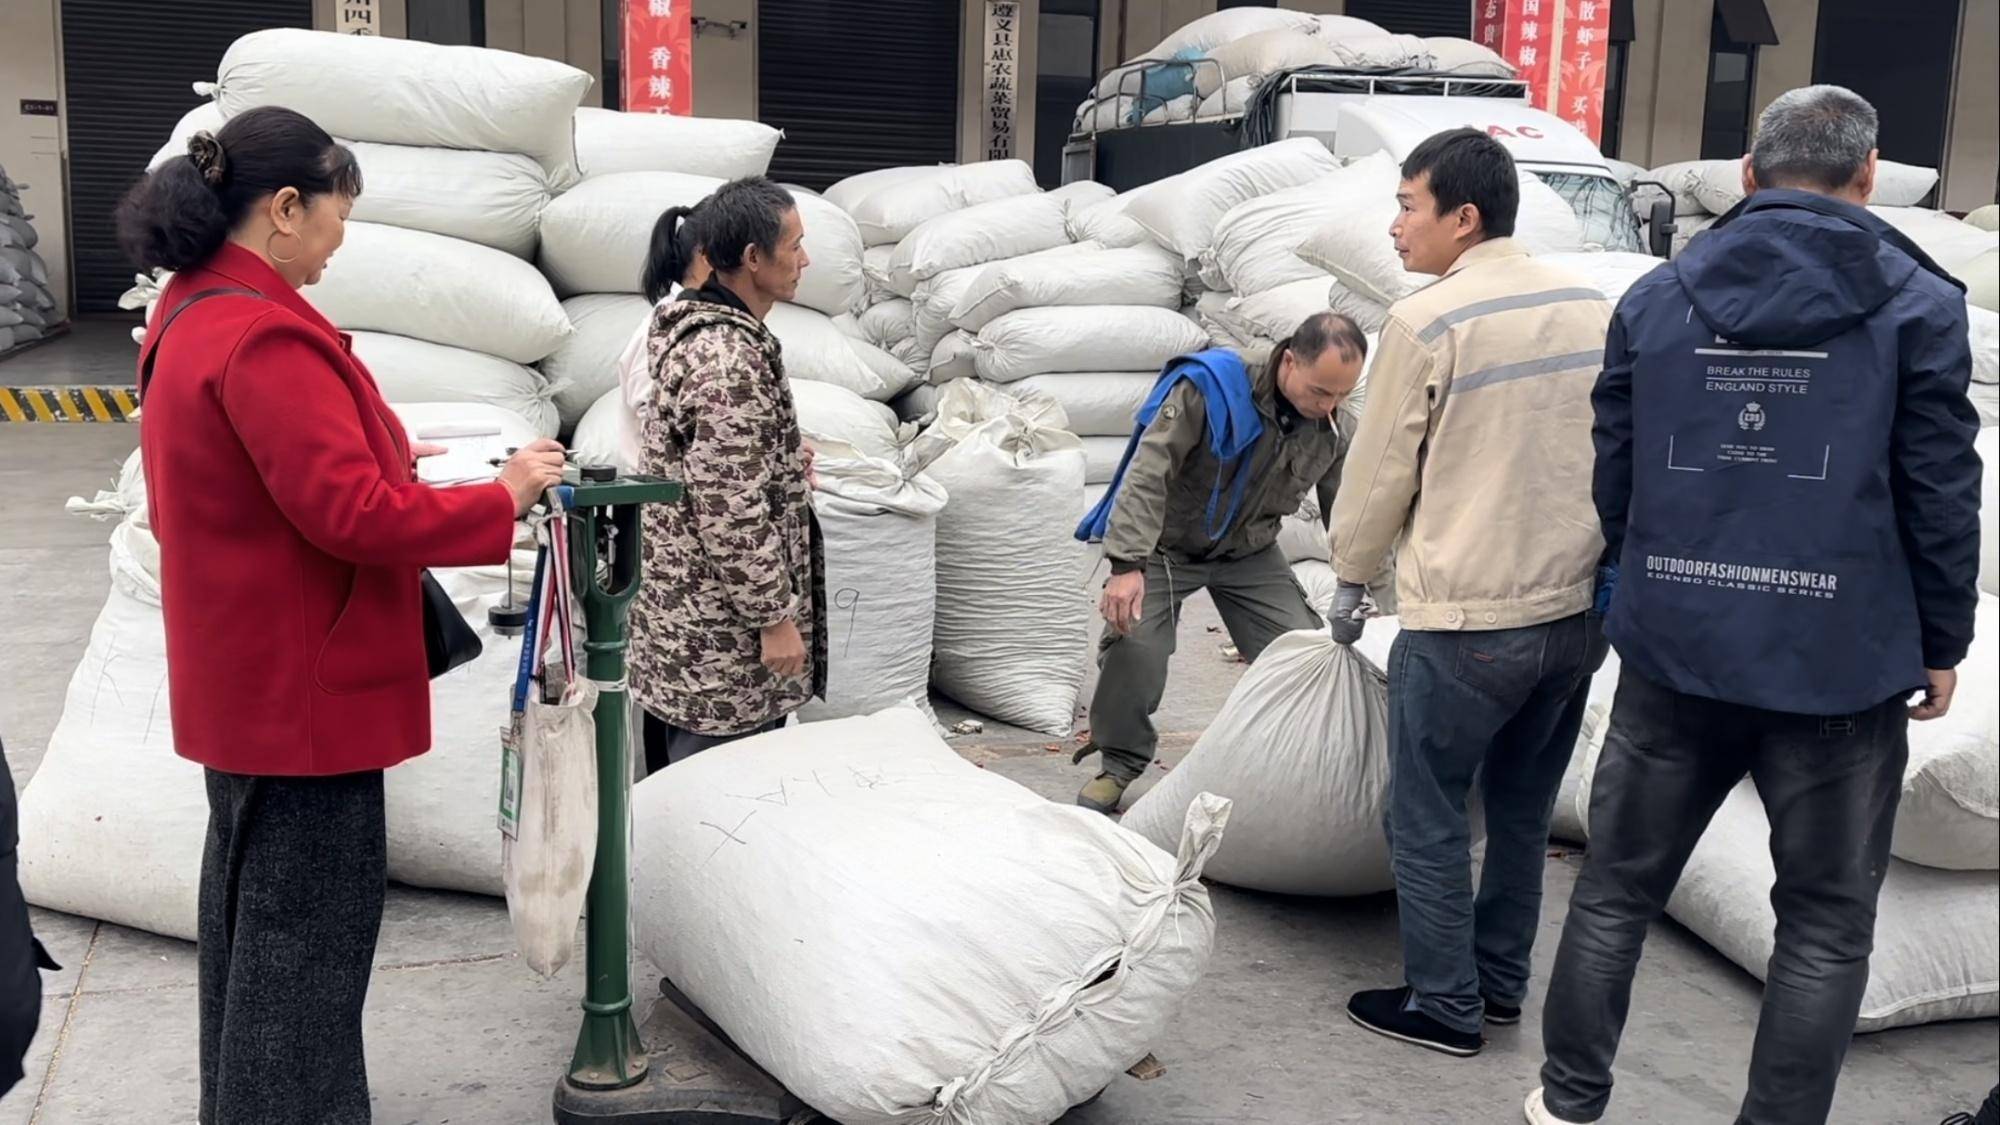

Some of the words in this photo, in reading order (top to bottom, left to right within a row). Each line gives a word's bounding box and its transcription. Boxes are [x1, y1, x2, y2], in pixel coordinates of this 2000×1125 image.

[989, 3, 1014, 160] 遵义县惠农蔬菜贸易有限
[1706, 365, 1745, 377] BREAK
[1747, 367, 1769, 377] THE
[1771, 367, 1811, 379] RULES
[1705, 381, 1765, 392] ENGLAND
[1768, 383, 1808, 394] STYLE
[1646, 555, 1837, 590] OUTDOORFASHIONMENSWEAR
[1647, 572, 1703, 584] EDENBO
[1707, 579, 1771, 592] CLASSIC
[1777, 587, 1834, 599] SERIES
